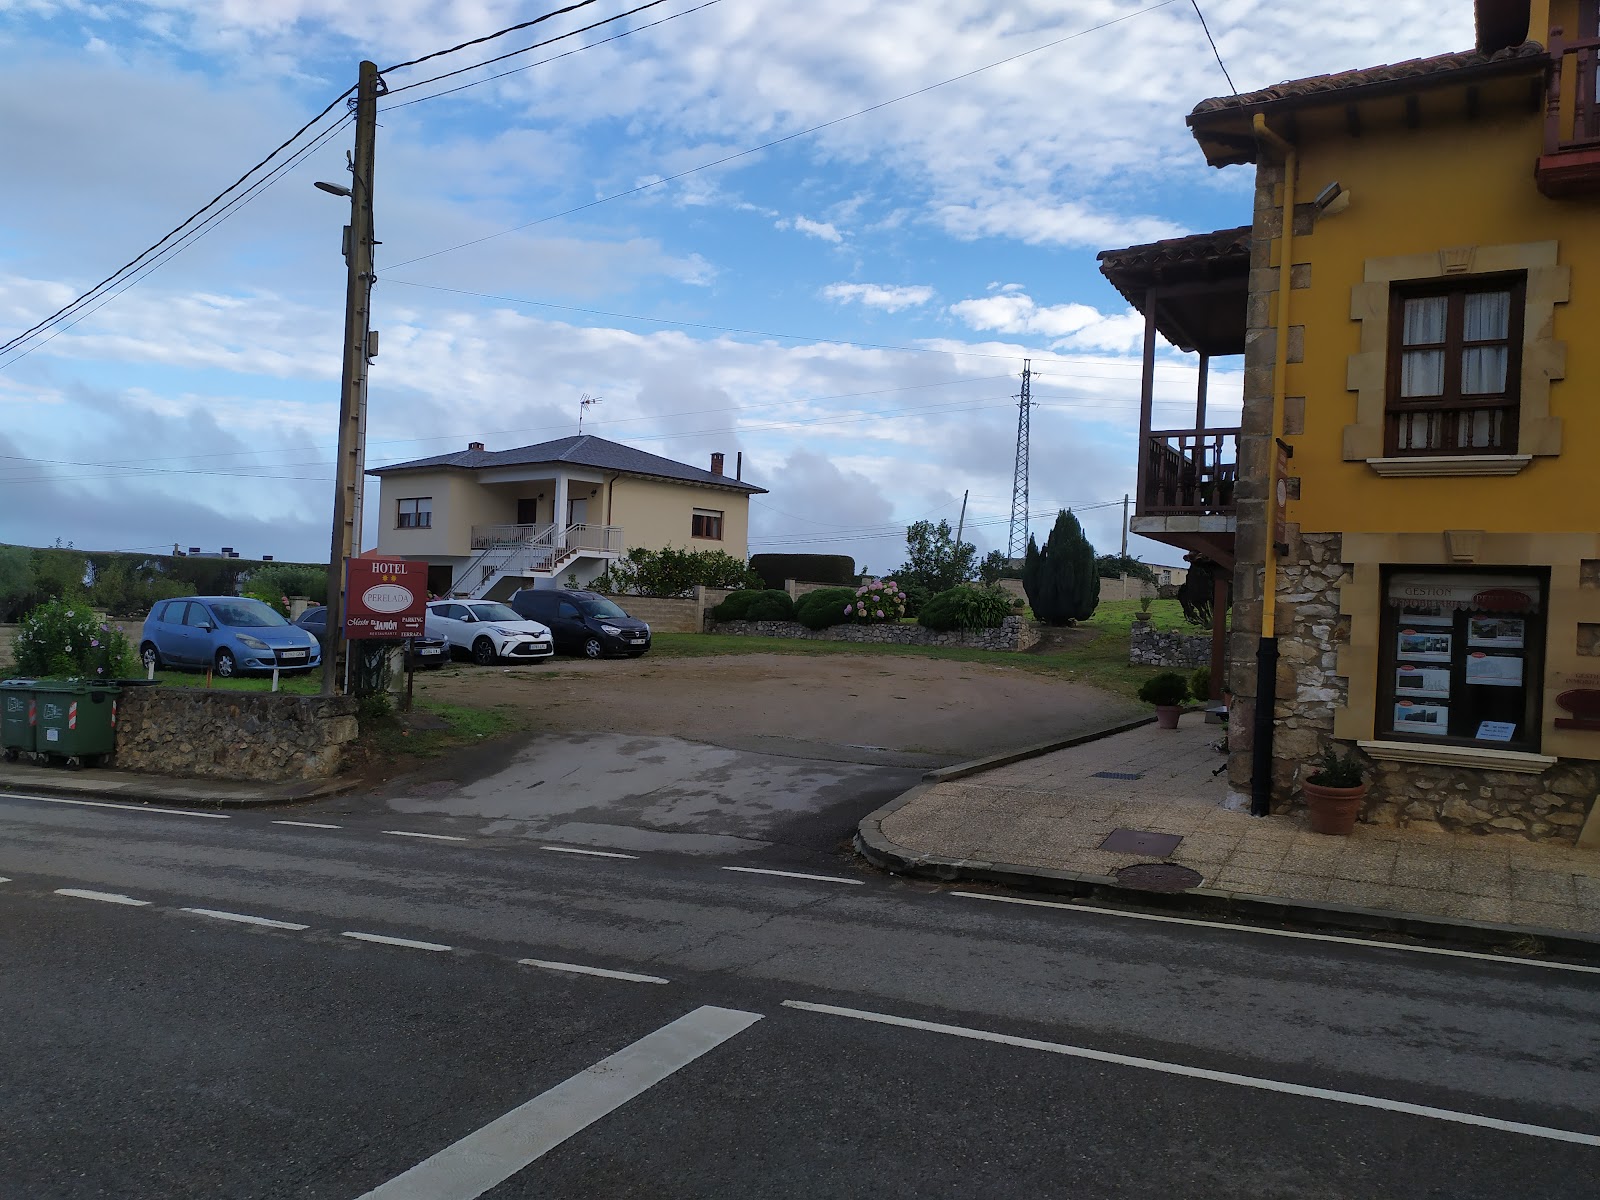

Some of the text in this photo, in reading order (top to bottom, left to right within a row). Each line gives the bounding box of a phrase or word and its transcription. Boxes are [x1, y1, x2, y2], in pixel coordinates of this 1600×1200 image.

[372, 562, 408, 574] HOTEL
[367, 593, 409, 603] PERELADA
[374, 620, 398, 631] JAMÓN
